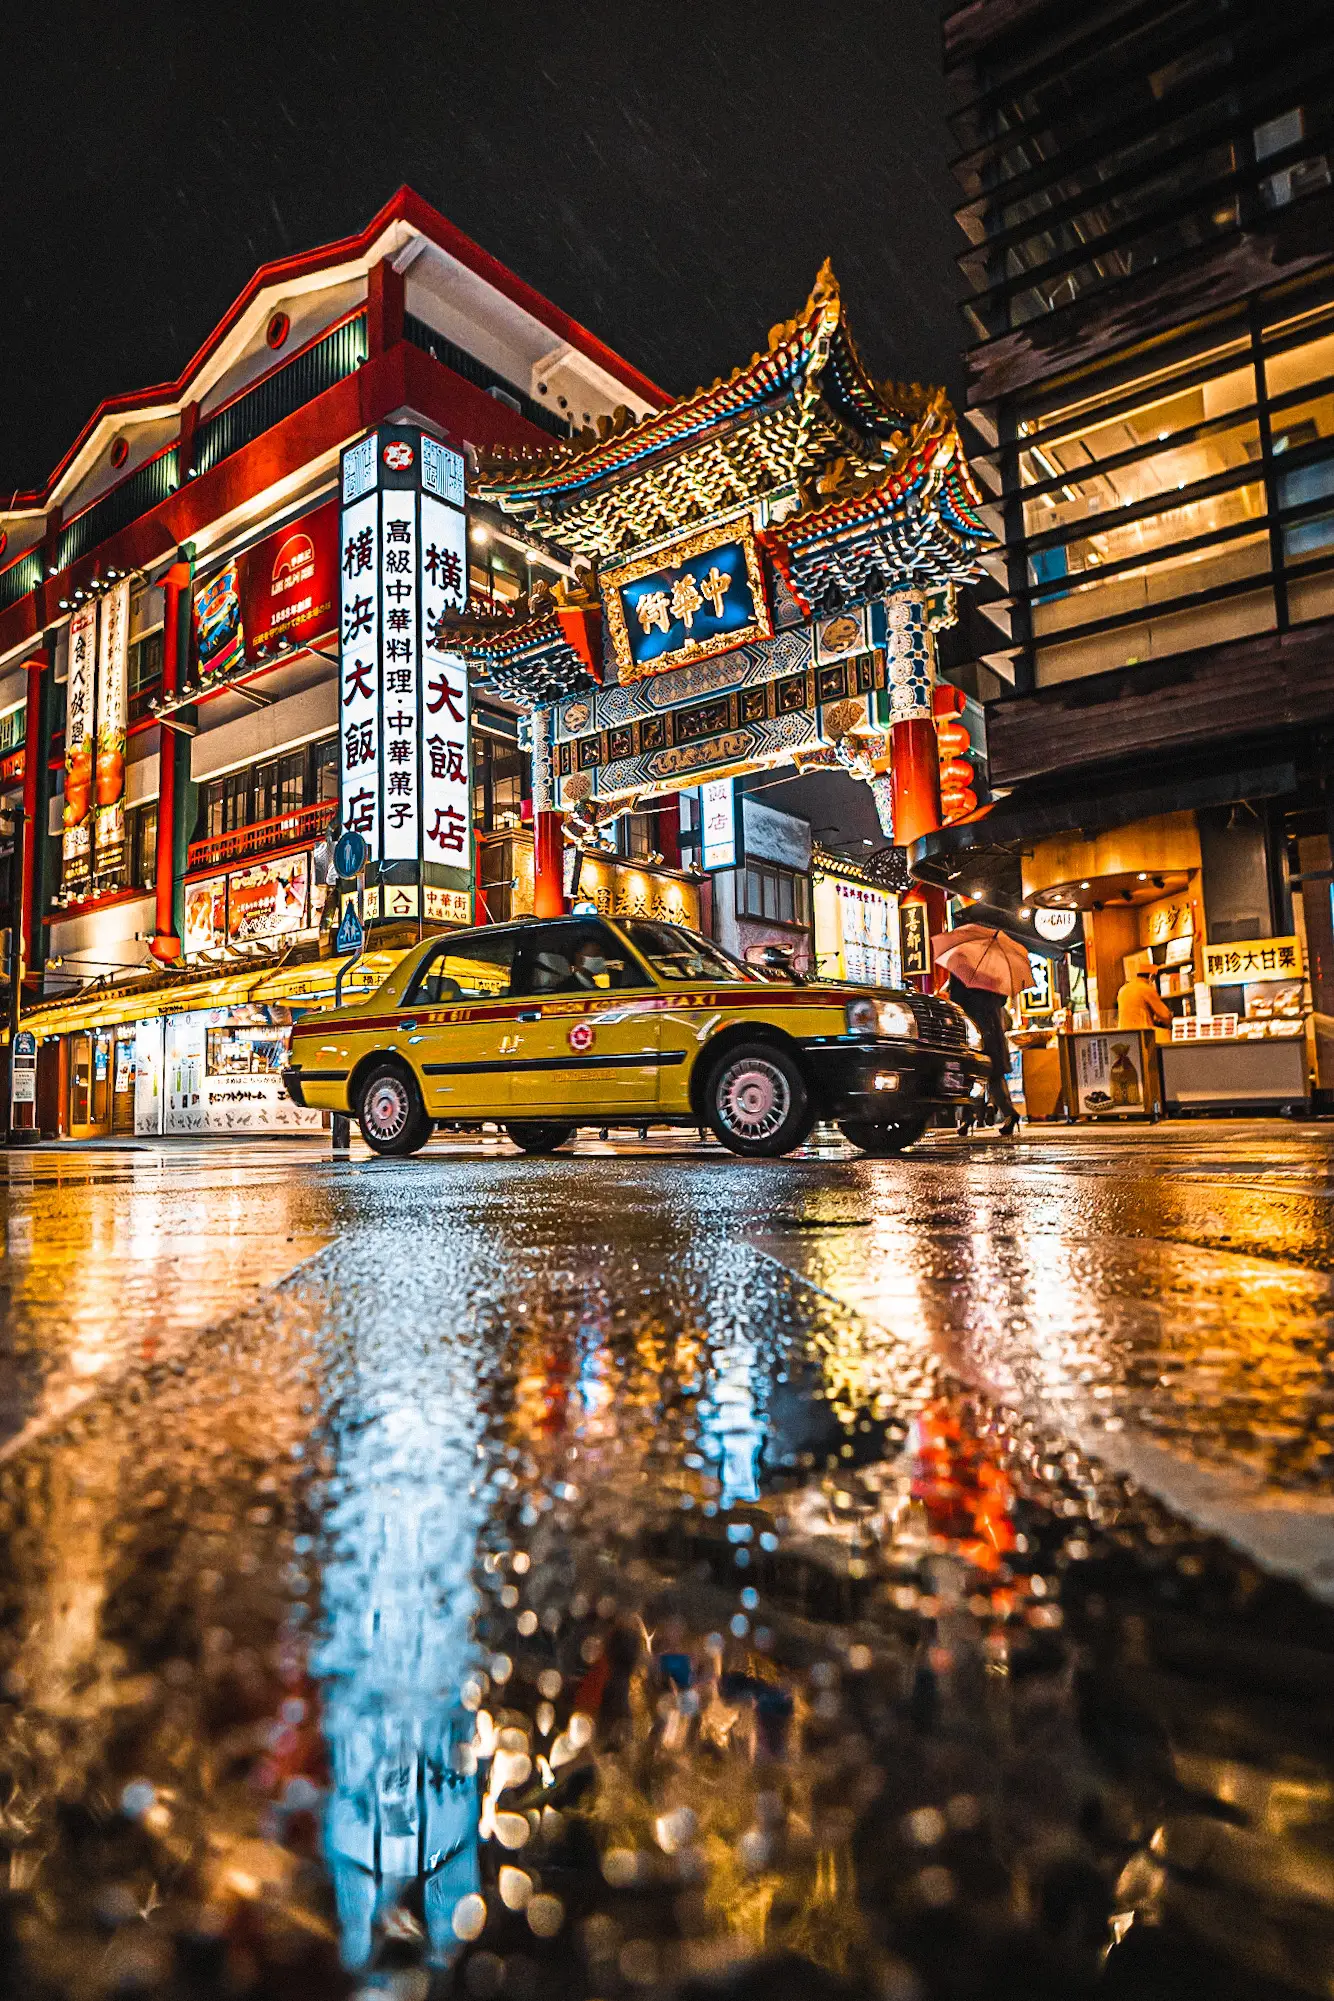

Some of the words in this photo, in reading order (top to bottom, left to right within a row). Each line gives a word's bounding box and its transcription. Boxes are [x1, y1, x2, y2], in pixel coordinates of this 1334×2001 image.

[635, 566, 732, 635] 中華街
[71, 635, 86, 745] 食べ放題
[342, 526, 376, 833] 横浜大飯店
[392, 889, 413, 914] 入口
[426, 891, 467, 911] 中華街
[427, 906, 467, 920] 大通り入口
[1207, 945, 1296, 975] 聘珍大甘栗
[665, 993, 717, 1007] TAXI
